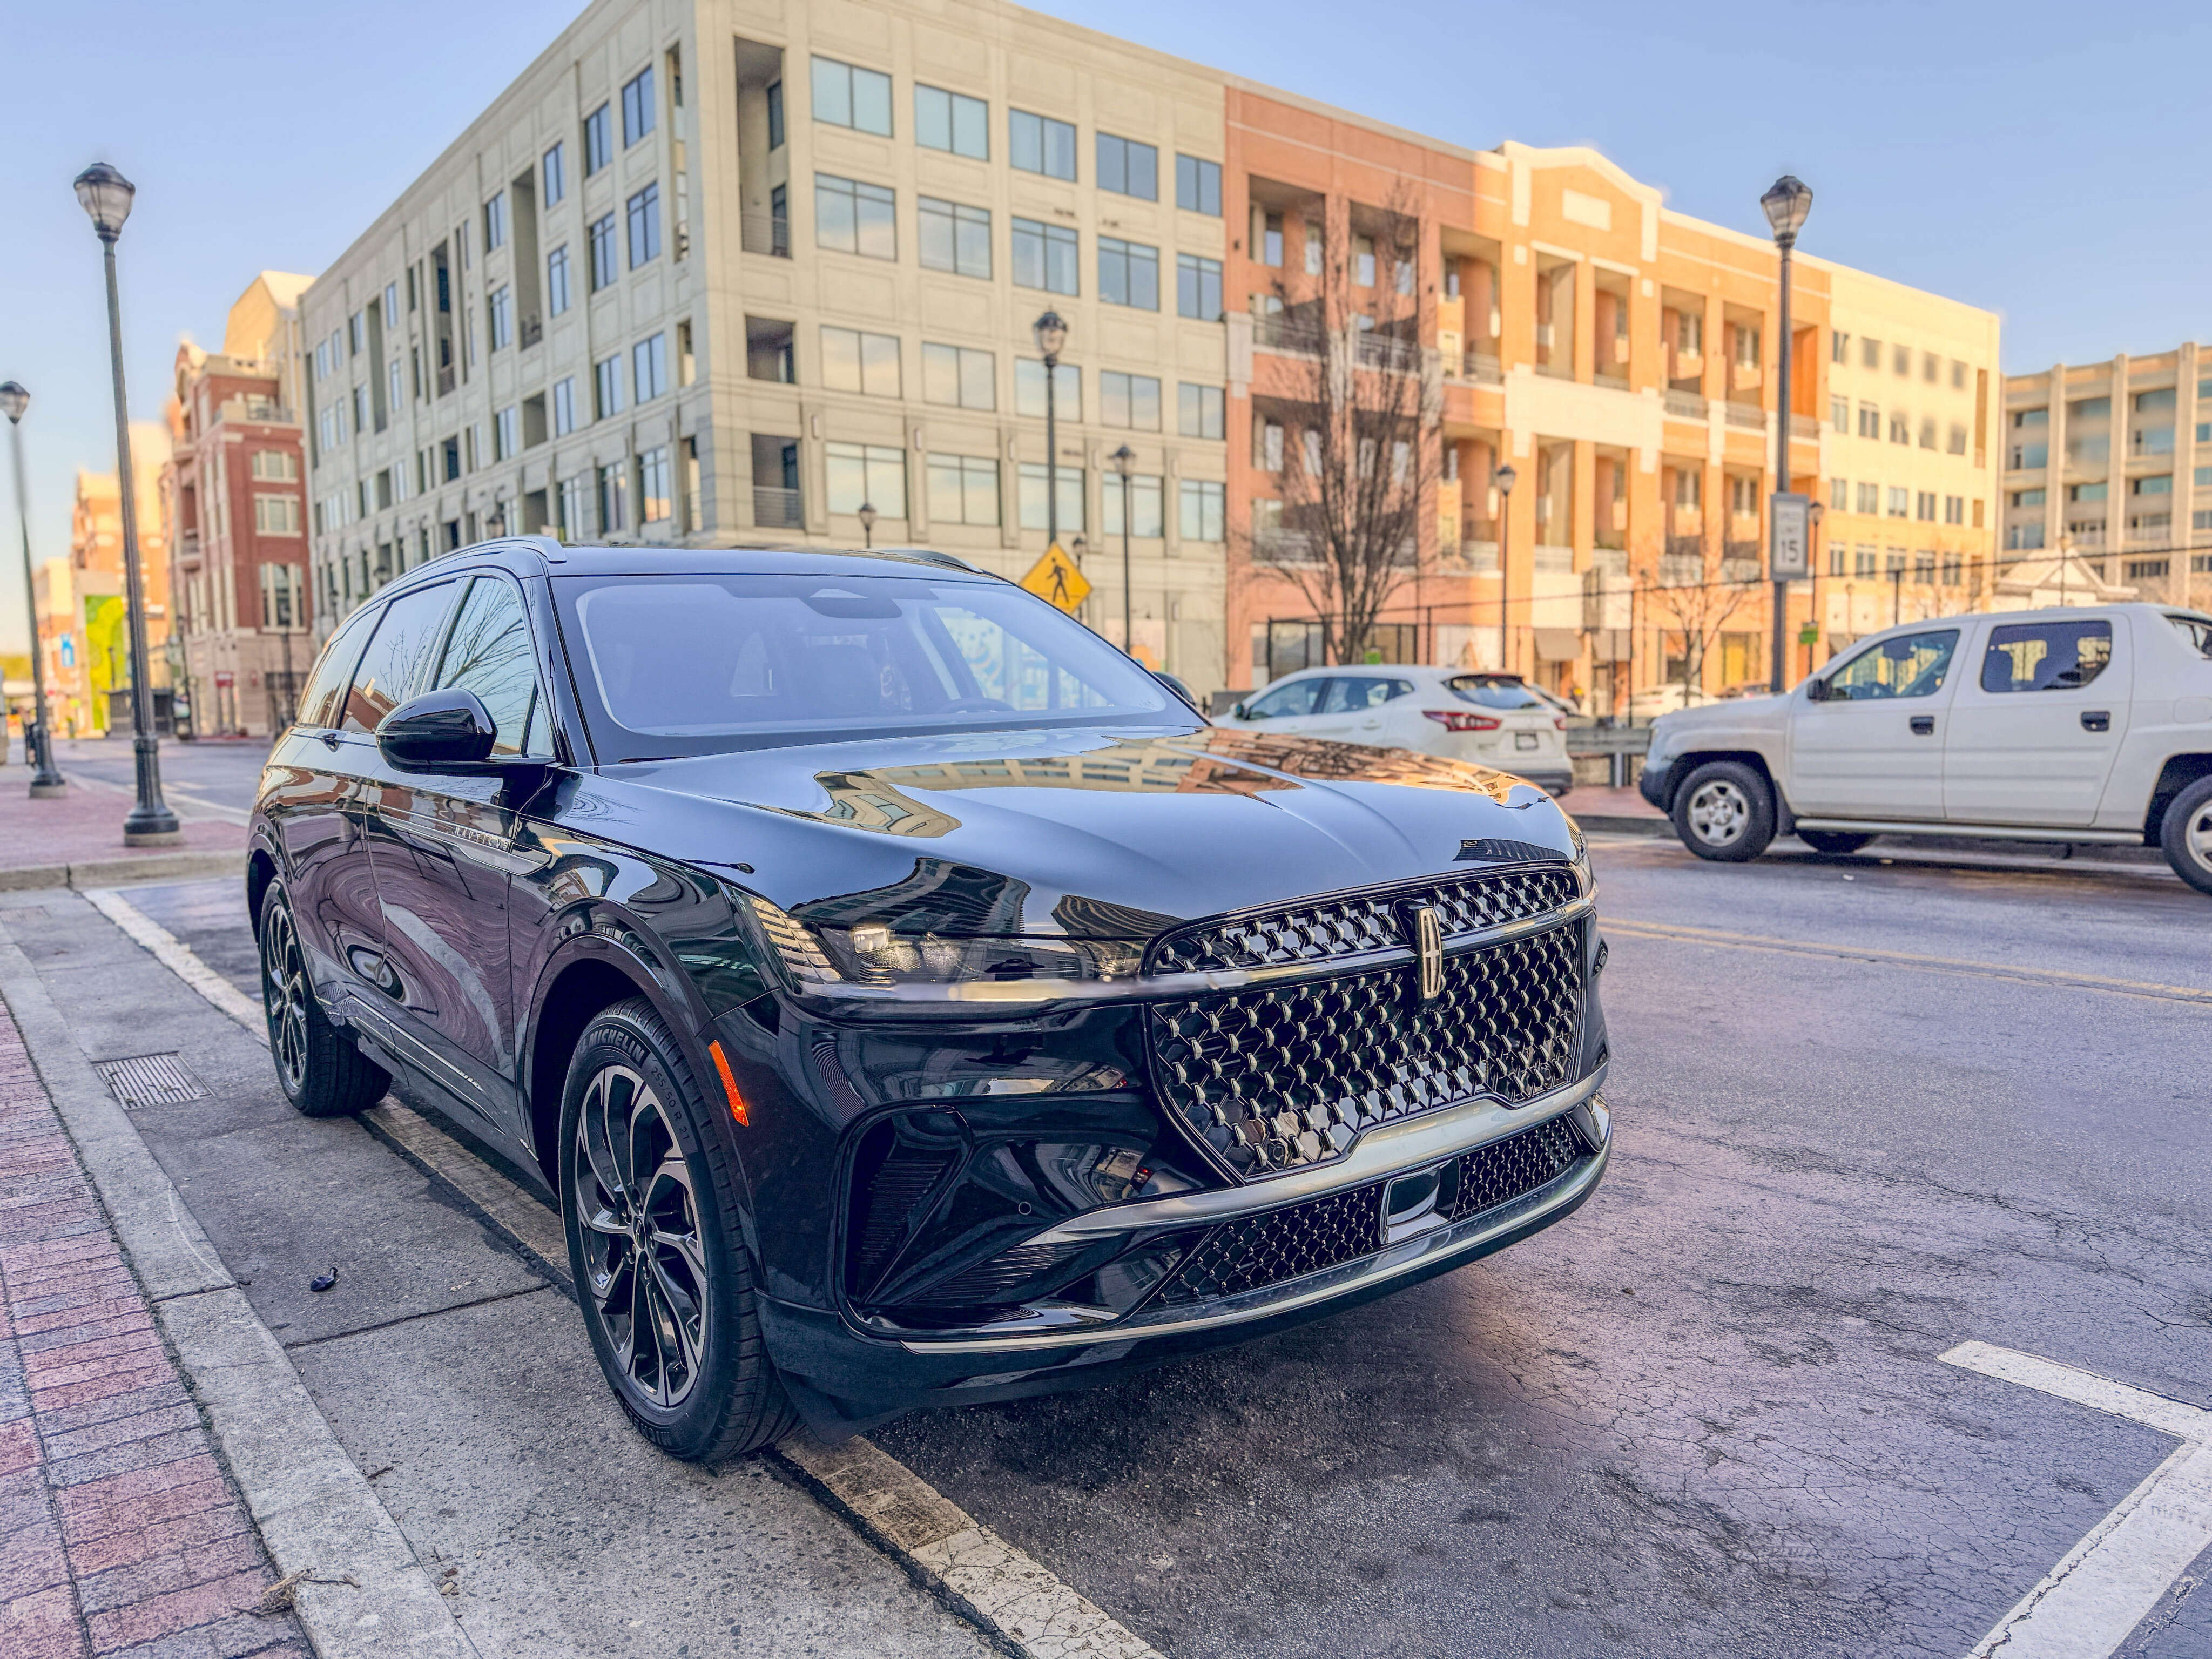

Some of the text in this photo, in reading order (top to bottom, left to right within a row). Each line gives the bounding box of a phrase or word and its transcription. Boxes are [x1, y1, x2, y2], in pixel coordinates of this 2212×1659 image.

[1781, 539, 1799, 563] 15
[589, 1028, 645, 1063] MICHELIN
[651, 1067, 691, 1140] 255/50 R 21
